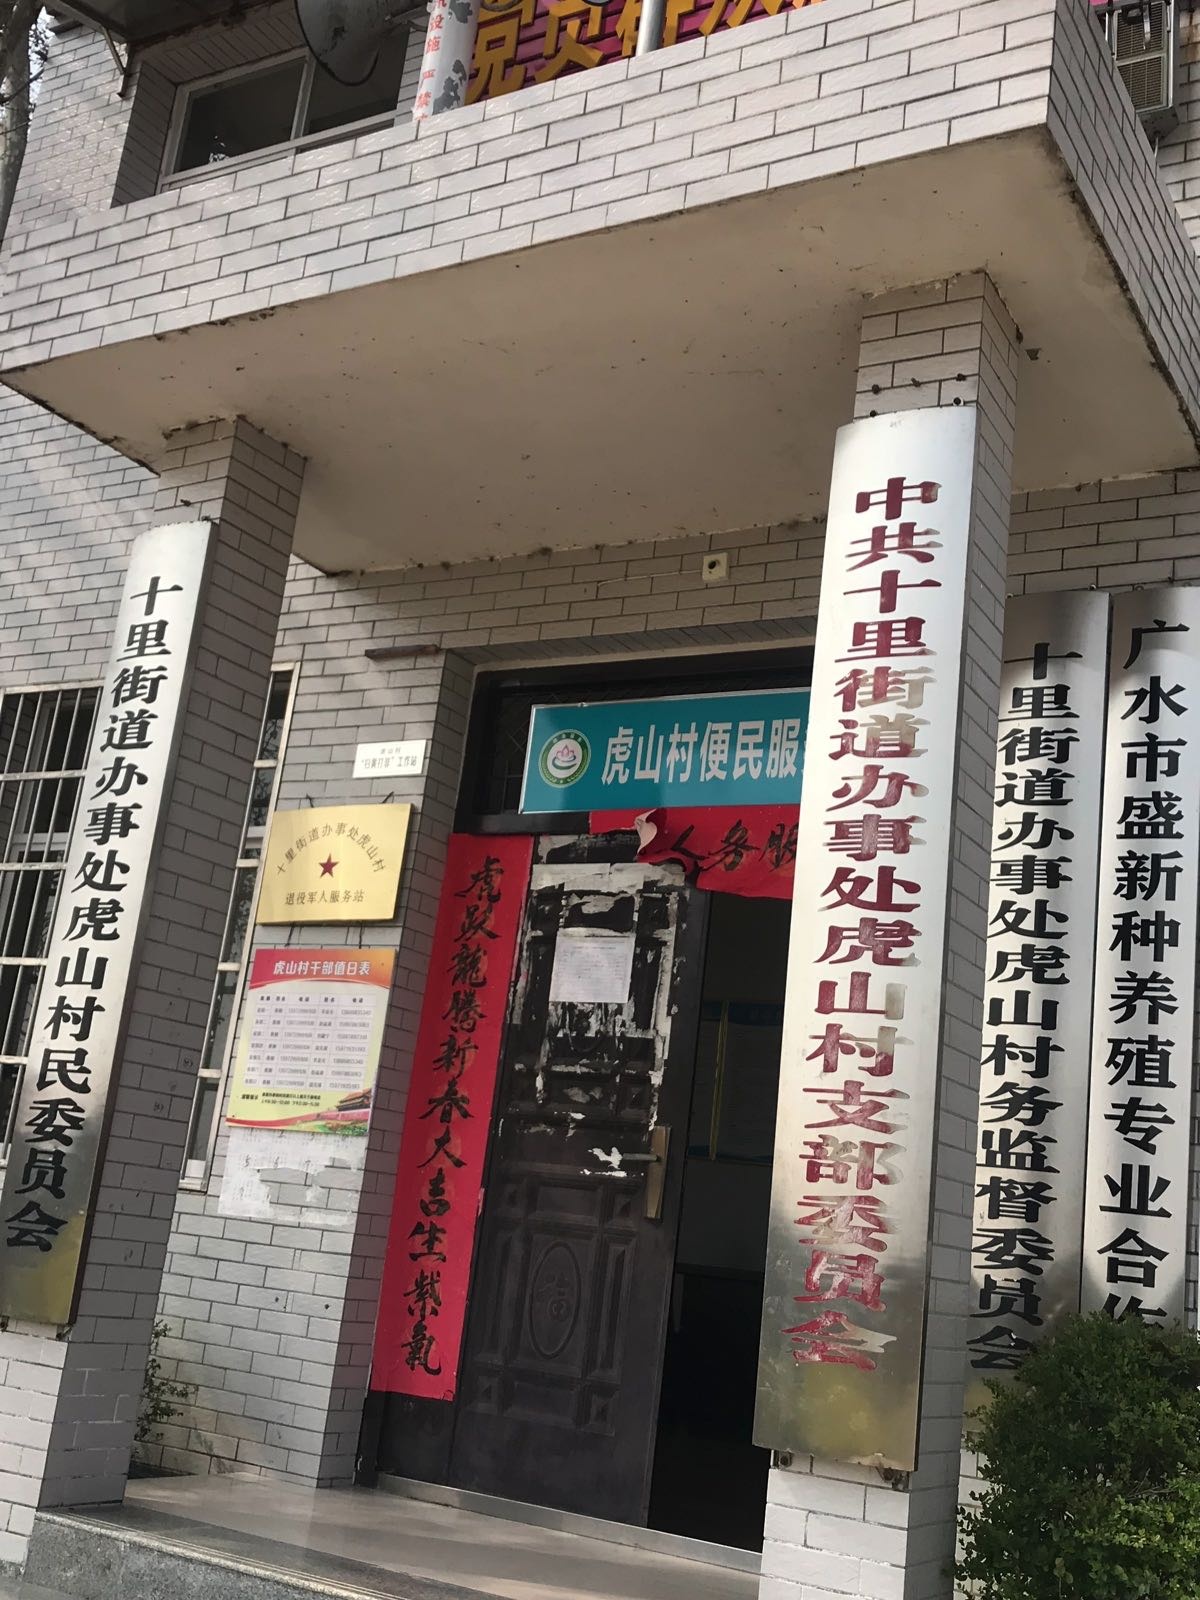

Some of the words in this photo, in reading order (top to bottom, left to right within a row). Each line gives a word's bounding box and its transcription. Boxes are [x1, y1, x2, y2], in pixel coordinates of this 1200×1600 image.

[600, 718, 808, 786] 虎山村便民服
[277, 822, 387, 875] 十里街道办事处虎山村
[5, 576, 183, 1252] 十里街道办事处虎山村民委员会
[285, 889, 365, 906] 退役军人服务站
[781, 477, 942, 1371] 中共十里街道办事处虎山村支部委员会
[273, 960, 371, 975] 虎山村干部值日表
[966, 642, 1083, 1370] 十里街道办事处虎山村务监督委员会
